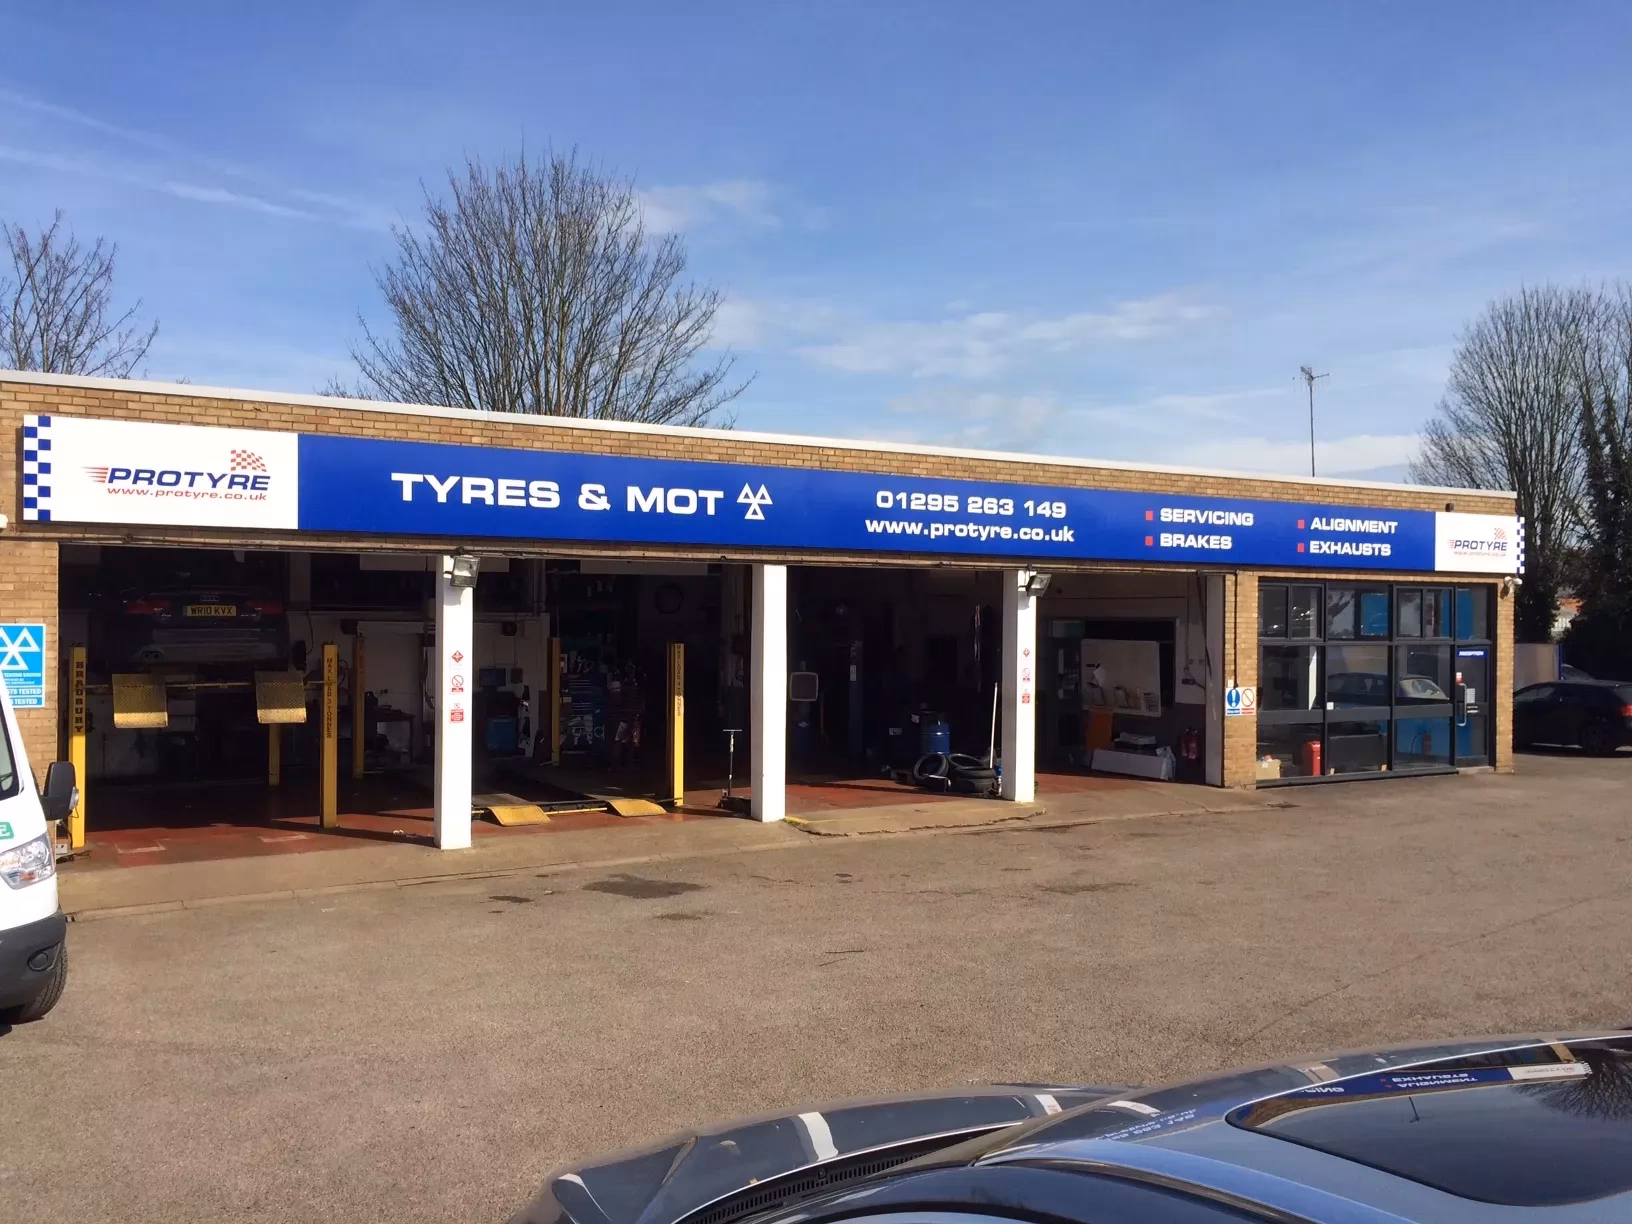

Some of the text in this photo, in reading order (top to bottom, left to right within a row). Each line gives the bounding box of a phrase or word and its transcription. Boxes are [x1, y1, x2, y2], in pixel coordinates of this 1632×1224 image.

[107, 467, 271, 491] PROTYRE
[107, 487, 267, 501] www.protyre.co.uk
[391, 472, 724, 516] TYRES & MOT
[876, 490, 1067, 518] 01295 263 149
[1160, 507, 1254, 527] SERVICING
[1310, 517, 1398, 535] ALIGNMENT
[865, 519, 1075, 543] www.protyre.co.uk
[1160, 534, 1233, 550] BRAKES
[1309, 541, 1392, 557] EXHAUSTS
[1454, 540, 1508, 551] PROTYRE
[214, 606, 233, 615] KVX
[74, 661, 84, 733] BRADBURY
